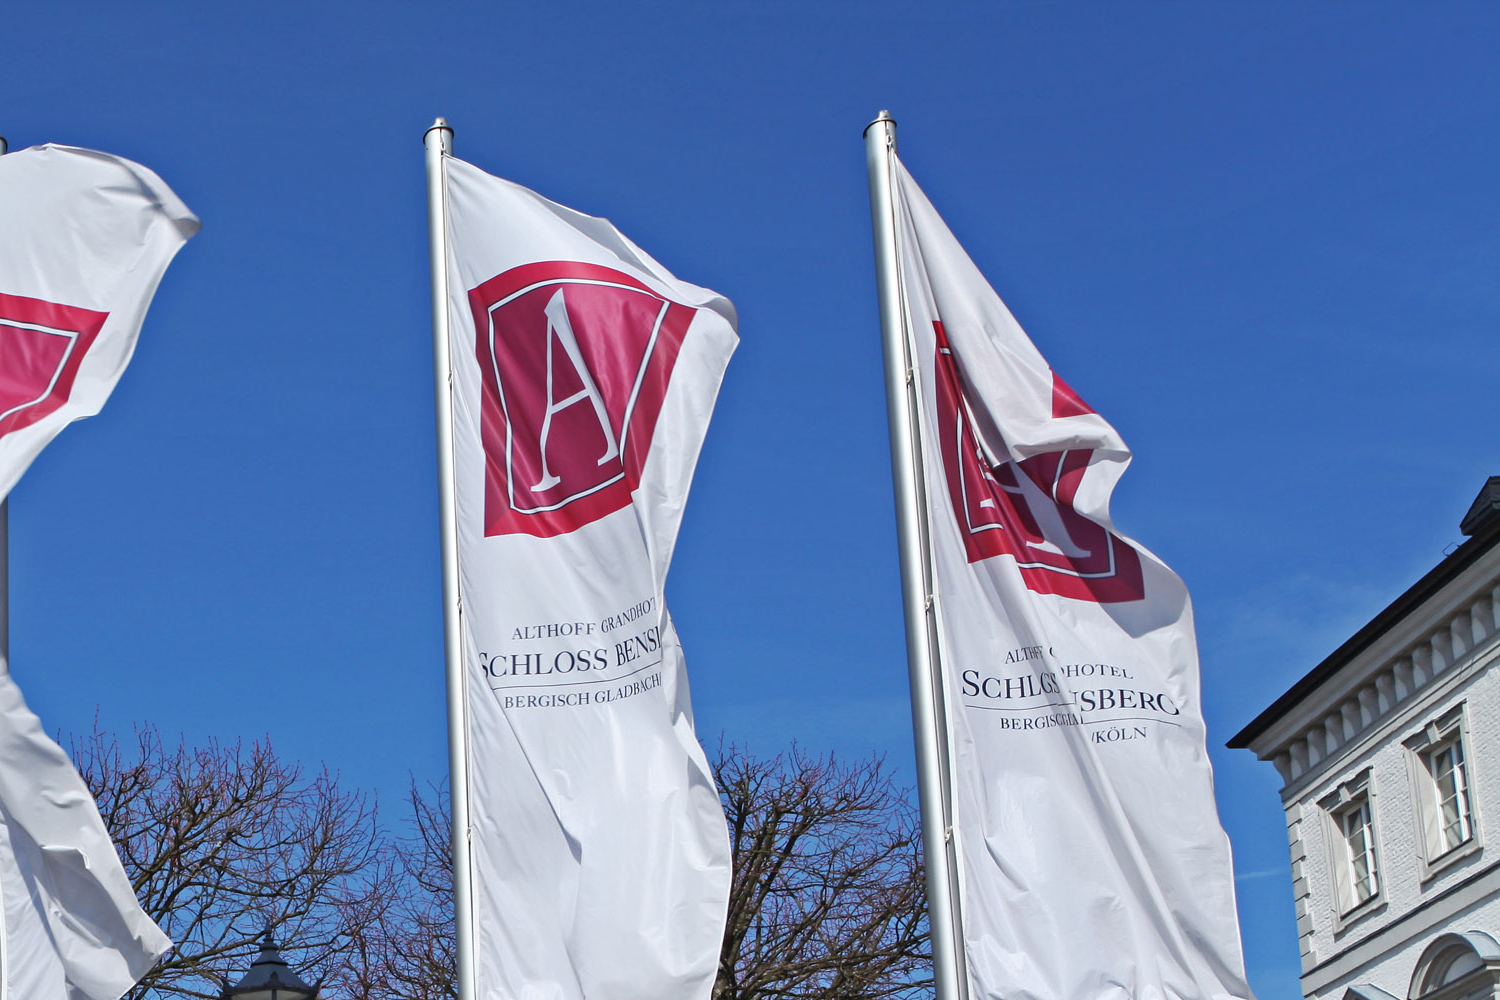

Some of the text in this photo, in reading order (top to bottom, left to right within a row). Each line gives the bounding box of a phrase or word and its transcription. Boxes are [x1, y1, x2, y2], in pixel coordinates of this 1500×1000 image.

[530, 287, 619, 492] A
[511, 622, 597, 641] ALTHOFF
[478, 648, 608, 679] SCHLOSS
[504, 692, 590, 709] BERGISCH
